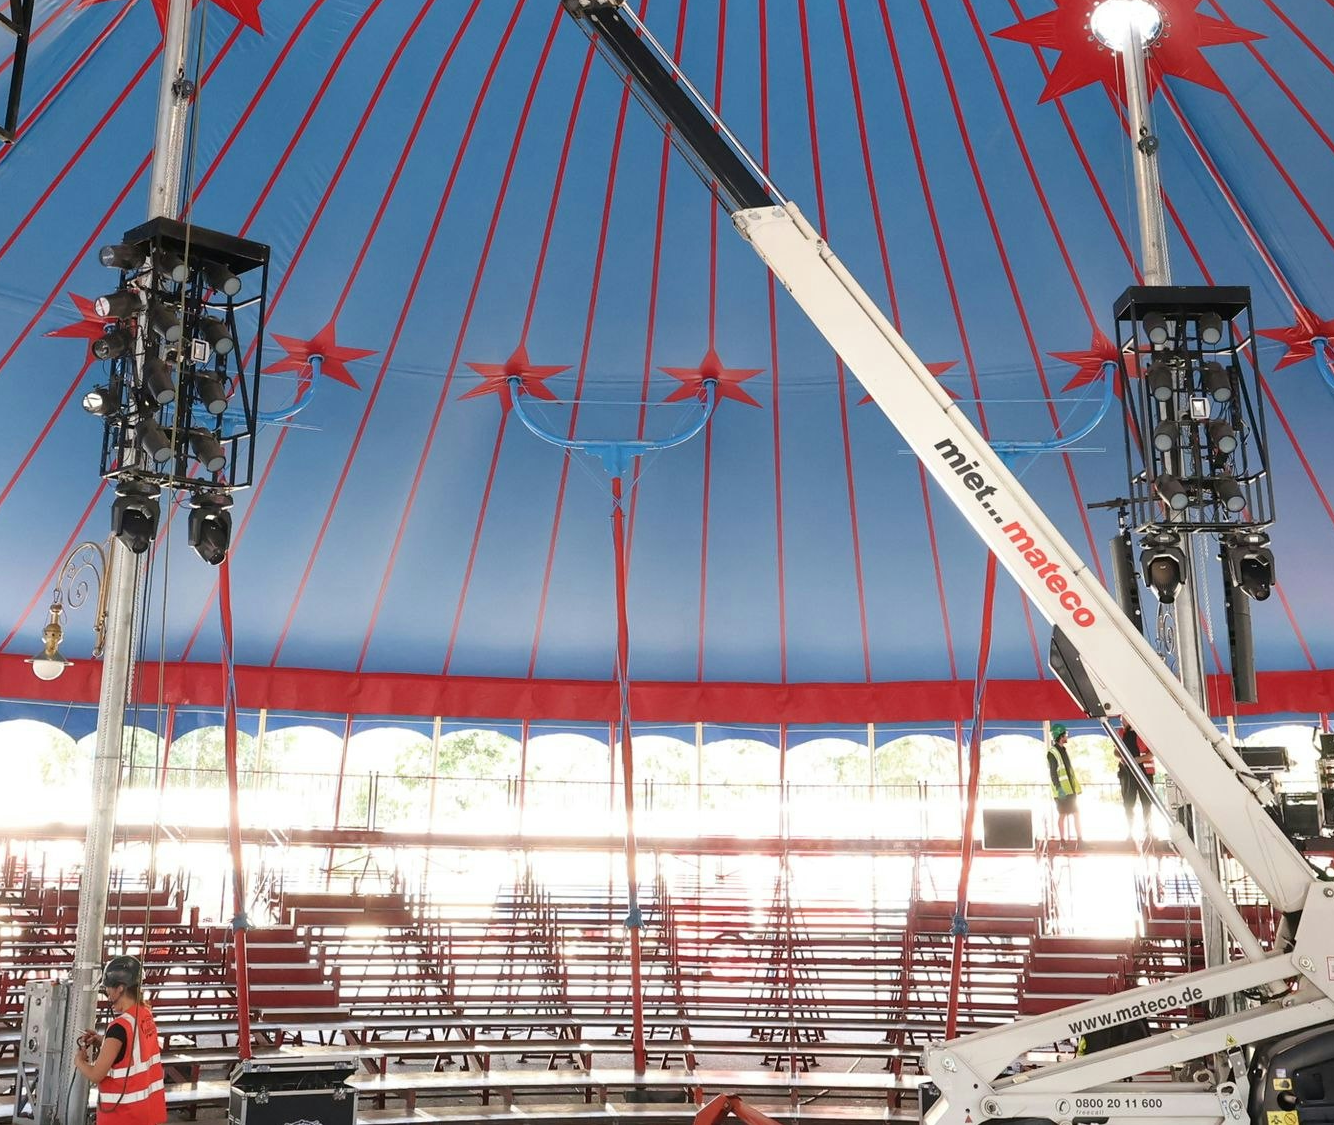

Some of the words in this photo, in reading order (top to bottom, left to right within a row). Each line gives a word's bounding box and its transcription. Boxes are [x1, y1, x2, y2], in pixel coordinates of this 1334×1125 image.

[1001, 520, 1096, 628] mateco
[1068, 986, 1203, 1035] www.mateco.de
[1075, 1098, 1104, 1108] 0800
[1107, 1098, 1121, 1108] 20
[1125, 1098, 1137, 1108] 11
[1141, 1098, 1163, 1108] 600
